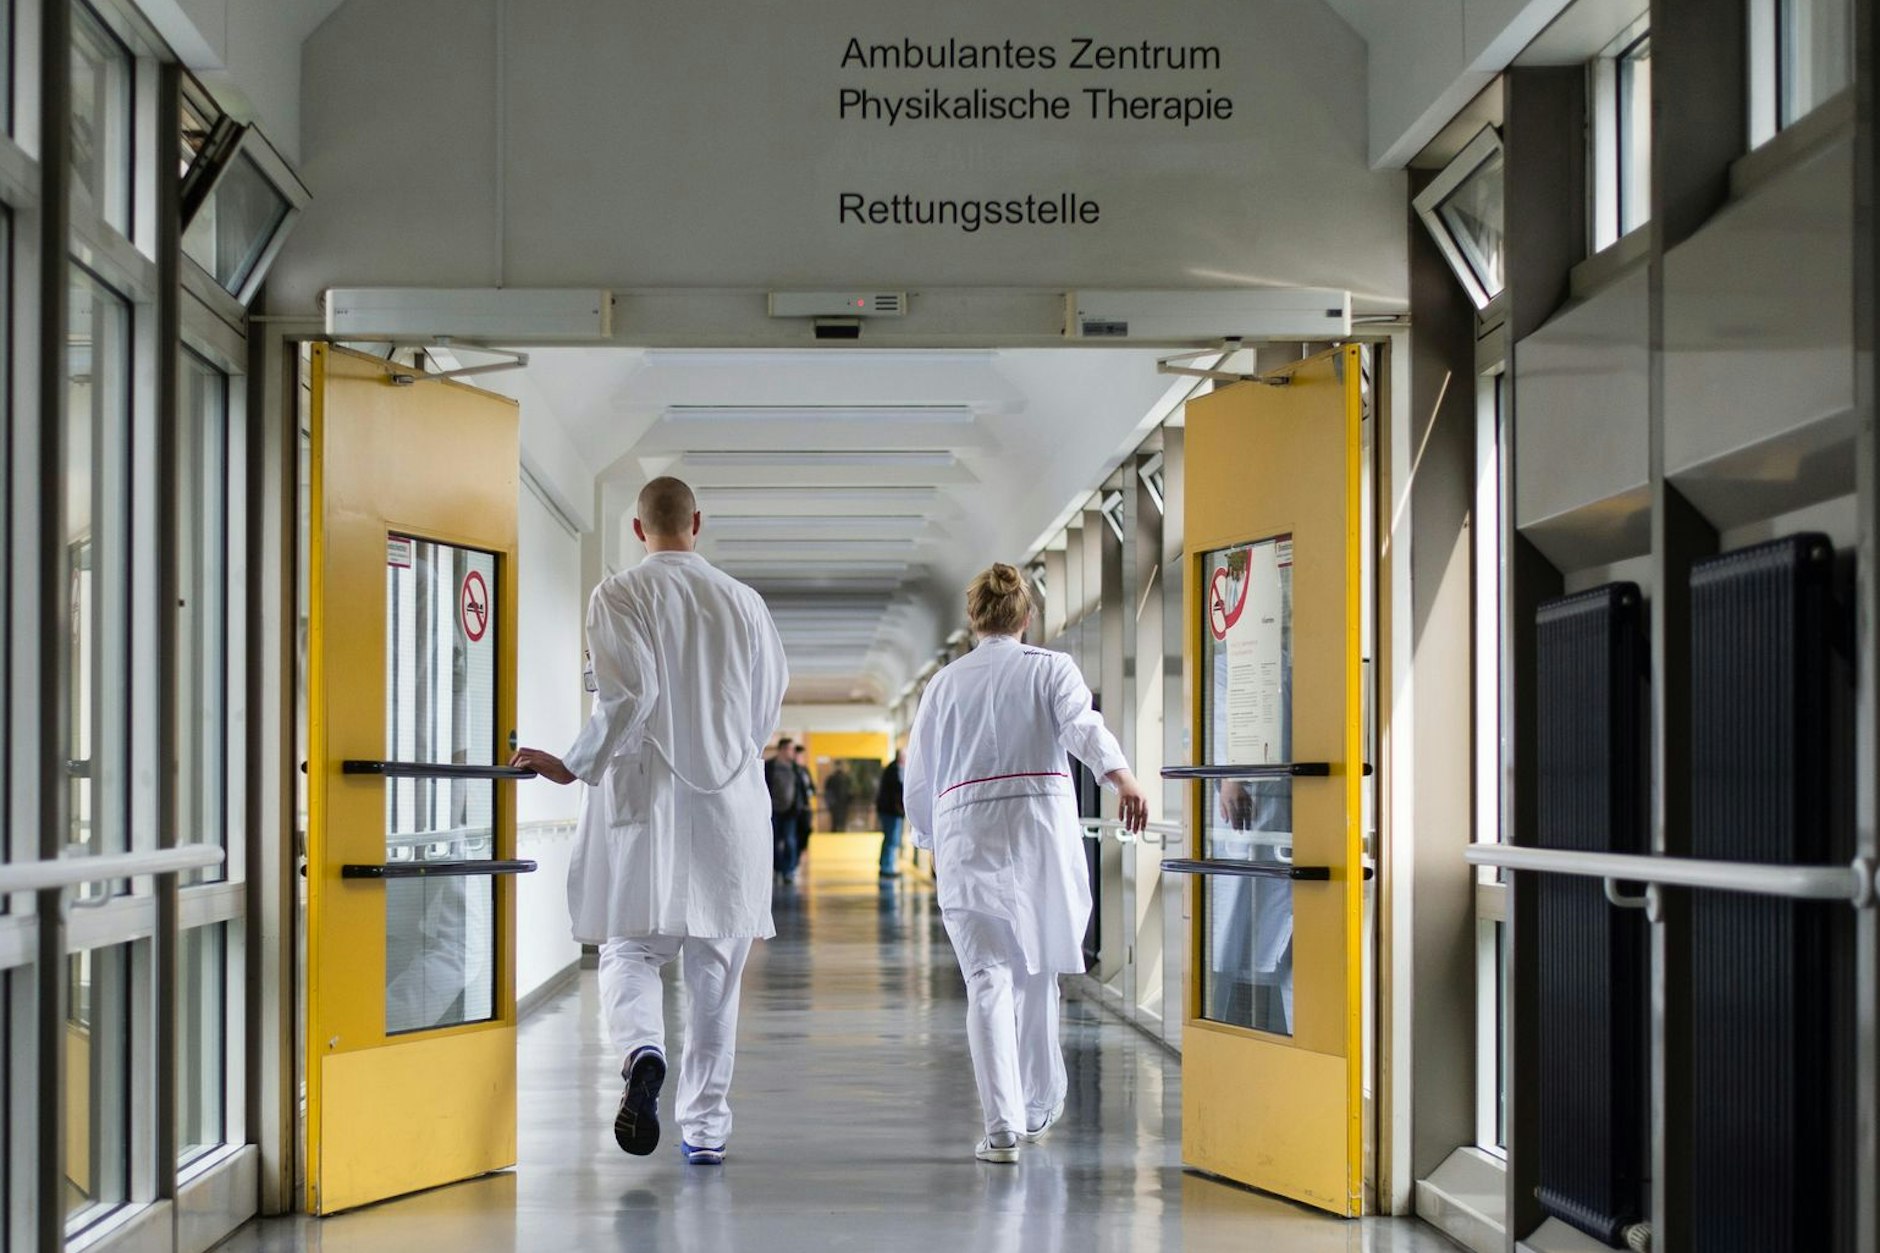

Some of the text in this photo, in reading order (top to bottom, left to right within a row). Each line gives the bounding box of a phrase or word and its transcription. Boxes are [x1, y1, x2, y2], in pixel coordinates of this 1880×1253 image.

[840, 37, 1221, 70] Ambulantes Zentrum
[839, 87, 1234, 127] Physikalische Therapie
[839, 192, 1100, 232] Rettungsstelle
